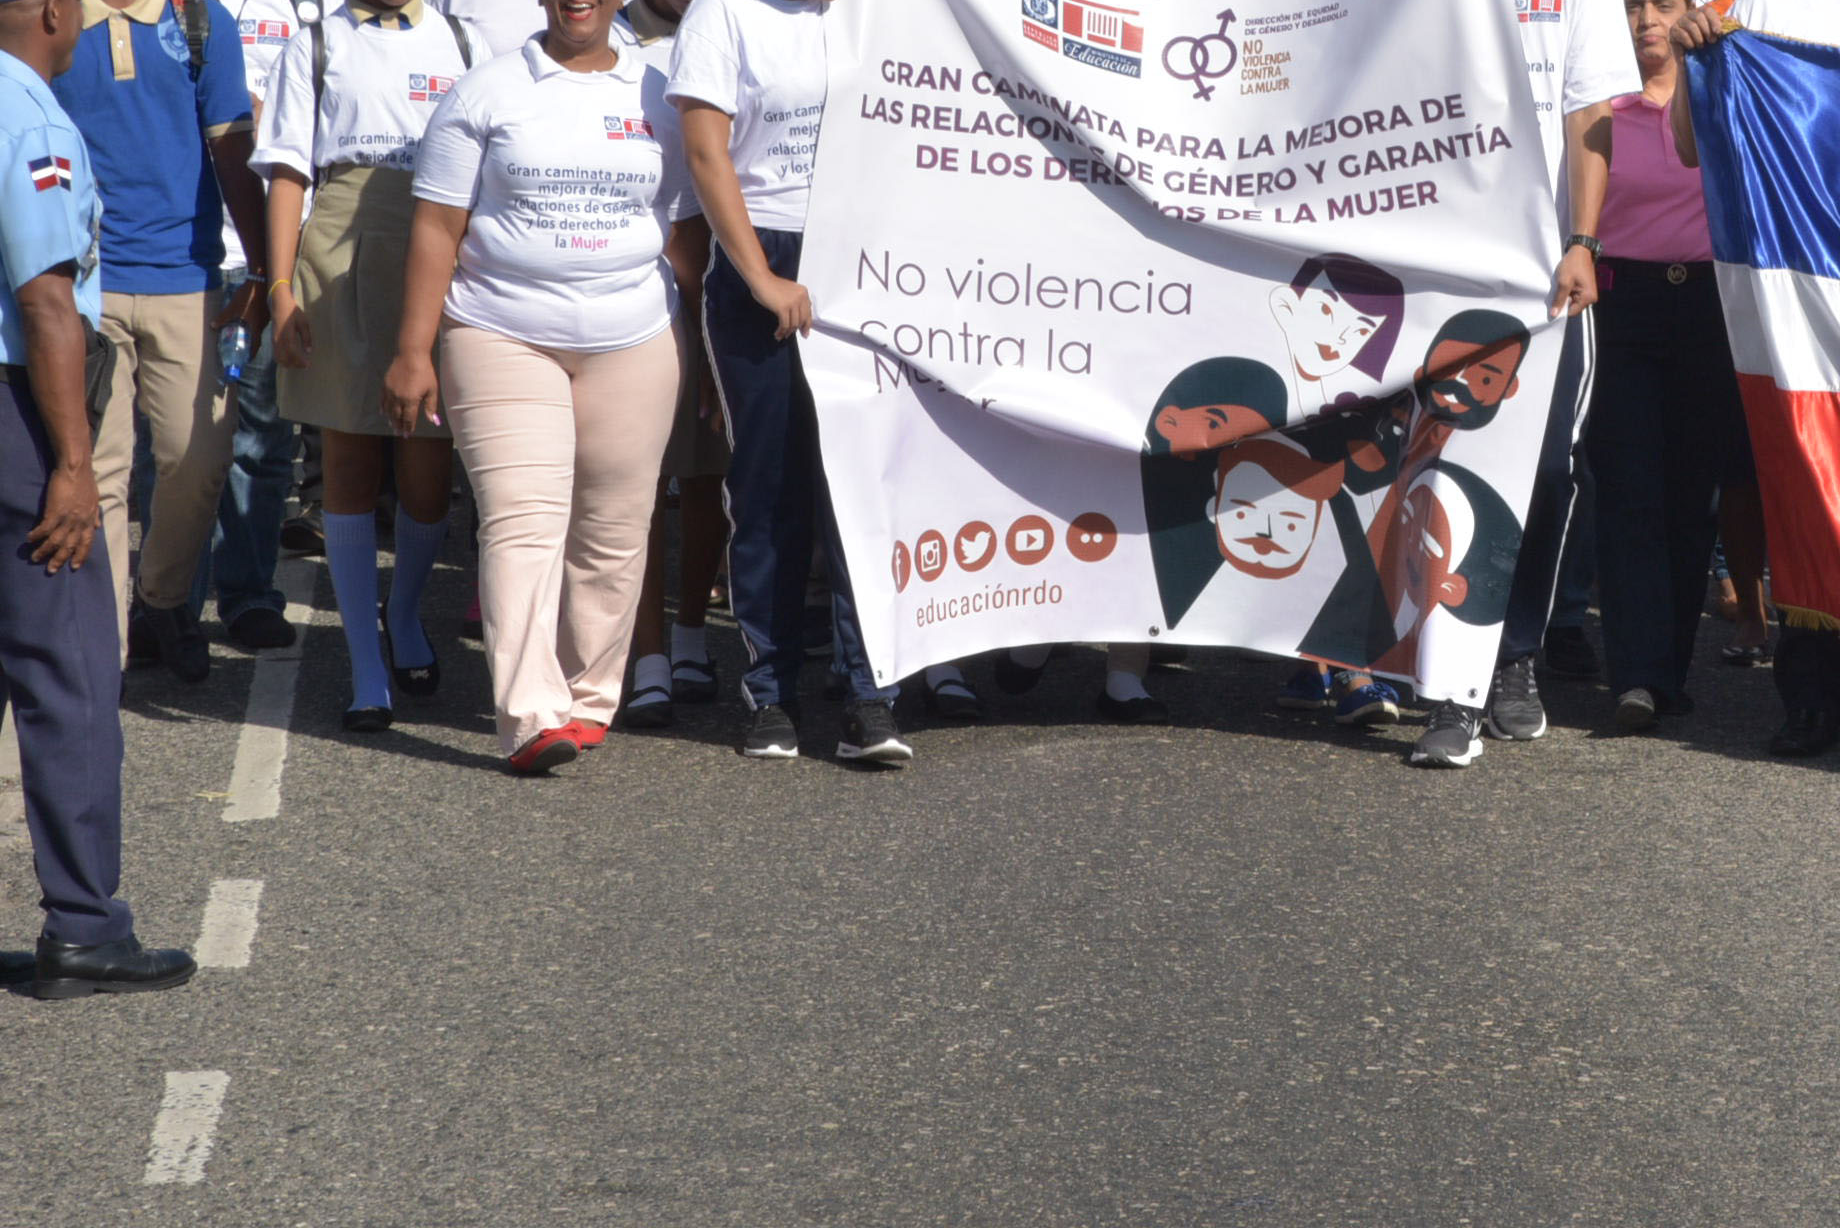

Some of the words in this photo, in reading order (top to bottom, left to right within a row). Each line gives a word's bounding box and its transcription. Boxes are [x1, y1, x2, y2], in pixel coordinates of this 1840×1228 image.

[1244, 14, 1292, 28] DIRECCIÓN
[1292, 12, 1304, 23] DE
[1306, 2, 1340, 19] EQUIDAD
[1244, 27, 1256, 36] DE
[1258, 21, 1293, 35] GÉNERO
[1294, 20, 1301, 30] Y
[1301, 9, 1349, 28] DESARROLLO
[1242, 39, 1264, 55] NO
[1064, 42, 1138, 76] Educación
[1242, 51, 1292, 67] VIOLENCIA
[1241, 65, 1283, 81] CONTRA
[1240, 83, 1253, 95] LA
[1253, 77, 1290, 95] MUJER
[764, 110, 792, 123] Gran
[794, 101, 824, 118] cami
[881, 59, 962, 92] GRAN
[972, 71, 1127, 142] CAMINATA
[1136, 126, 1227, 161] PARA
[1237, 134, 1276, 160] LA
[1285, 104, 1413, 155] MEJORA
[1419, 93, 1466, 124] DE
[789, 121, 821, 138] mejo
[360, 132, 415, 147] caminata
[860, 94, 904, 125] LAS
[911, 103, 1105, 158] RELACION
[1115, 152, 1154, 185] DE
[1163, 167, 1297, 198] GÉNERO
[1305, 160, 1327, 185] Y
[1337, 126, 1512, 178] GARANTÍA
[399, 150, 413, 164] de
[767, 141, 817, 157] relacion
[507, 163, 540, 178] Gran
[545, 166, 612, 182] caminata
[616, 171, 646, 184] para
[648, 171, 656, 184] la
[780, 163, 788, 178] y
[790, 159, 810, 174] los
[538, 183, 586, 197] mejora
[590, 182, 607, 196] de
[610, 185, 628, 198] las
[916, 144, 959, 172] DE
[970, 150, 1033, 179] LOS
[1217, 208, 1263, 222] DE
[1274, 203, 1317, 224] LA
[1327, 180, 1439, 221] MUJER
[514, 198, 580, 213] relaciones
[584, 200, 603, 213] de
[526, 218, 534, 231] y
[537, 216, 556, 230] los
[559, 217, 617, 231] derechos
[619, 217, 630, 228] de
[555, 235, 567, 249] la
[571, 236, 609, 251] Mujer
[857, 247, 926, 296] No
[945, 258, 1192, 316] violencia
[1047, 328, 1092, 375] la
[916, 579, 1063, 628] educaciónrdo
